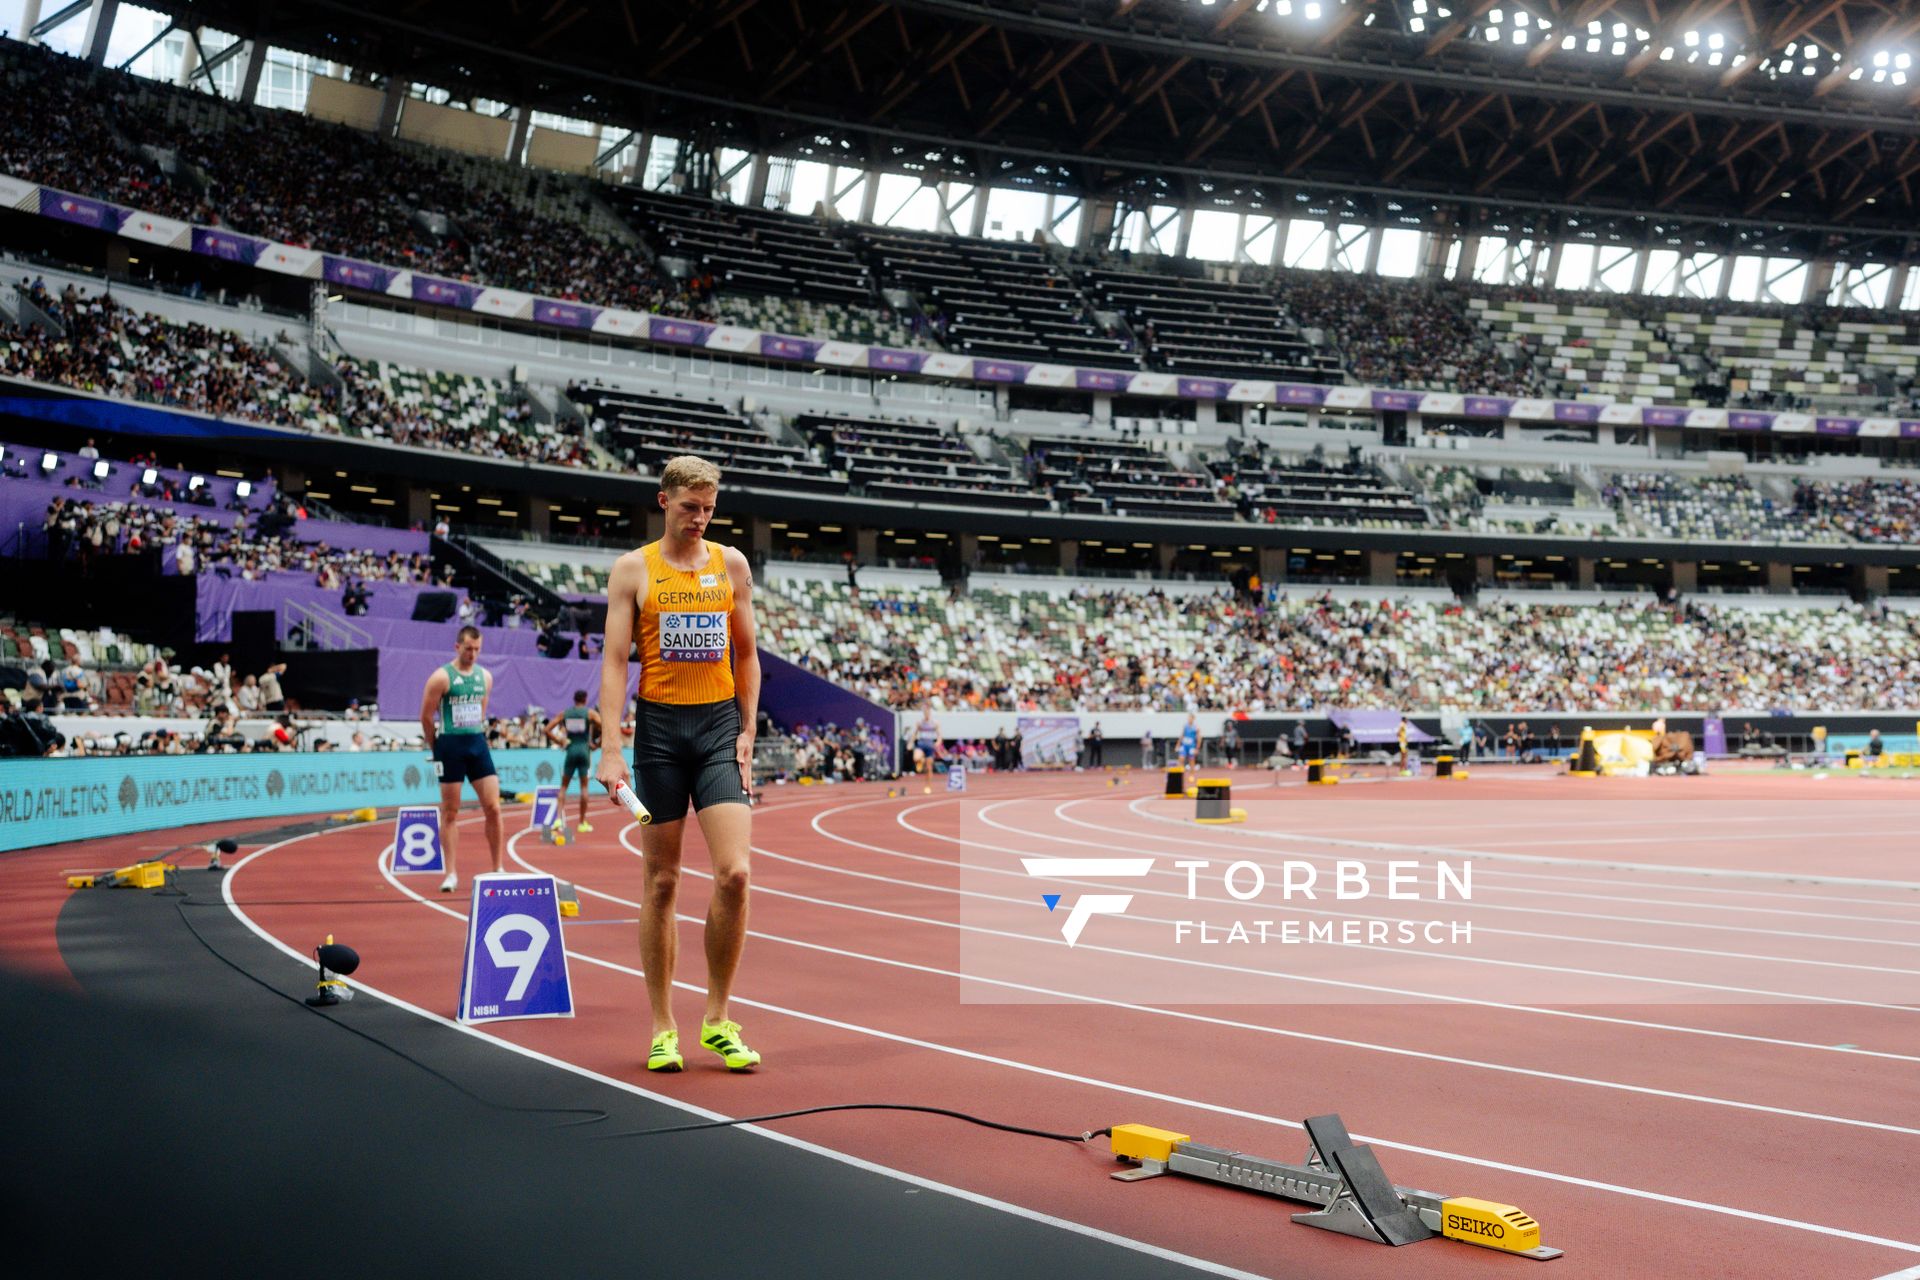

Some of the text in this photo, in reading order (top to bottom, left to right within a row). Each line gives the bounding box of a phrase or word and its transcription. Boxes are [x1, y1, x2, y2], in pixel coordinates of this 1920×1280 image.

[658, 589, 728, 605] GERMANY
[681, 614, 723, 628] TDK
[663, 632, 726, 648] SANDERS
[678, 651, 722, 659] TOKYO2
[144, 775, 260, 808] WORLD ATHLETICS
[290, 773, 331, 797] WORLD
[331, 769, 395, 794] ATHLETICS
[950, 772, 962, 788] 5
[36, 783, 108, 819] ATHLETICS
[538, 797, 558, 827] 7
[401, 822, 437, 867] 8
[483, 913, 551, 1002] 9
[473, 1004, 499, 1017] NISHI
[1448, 1214, 1505, 1239] SEIKO
